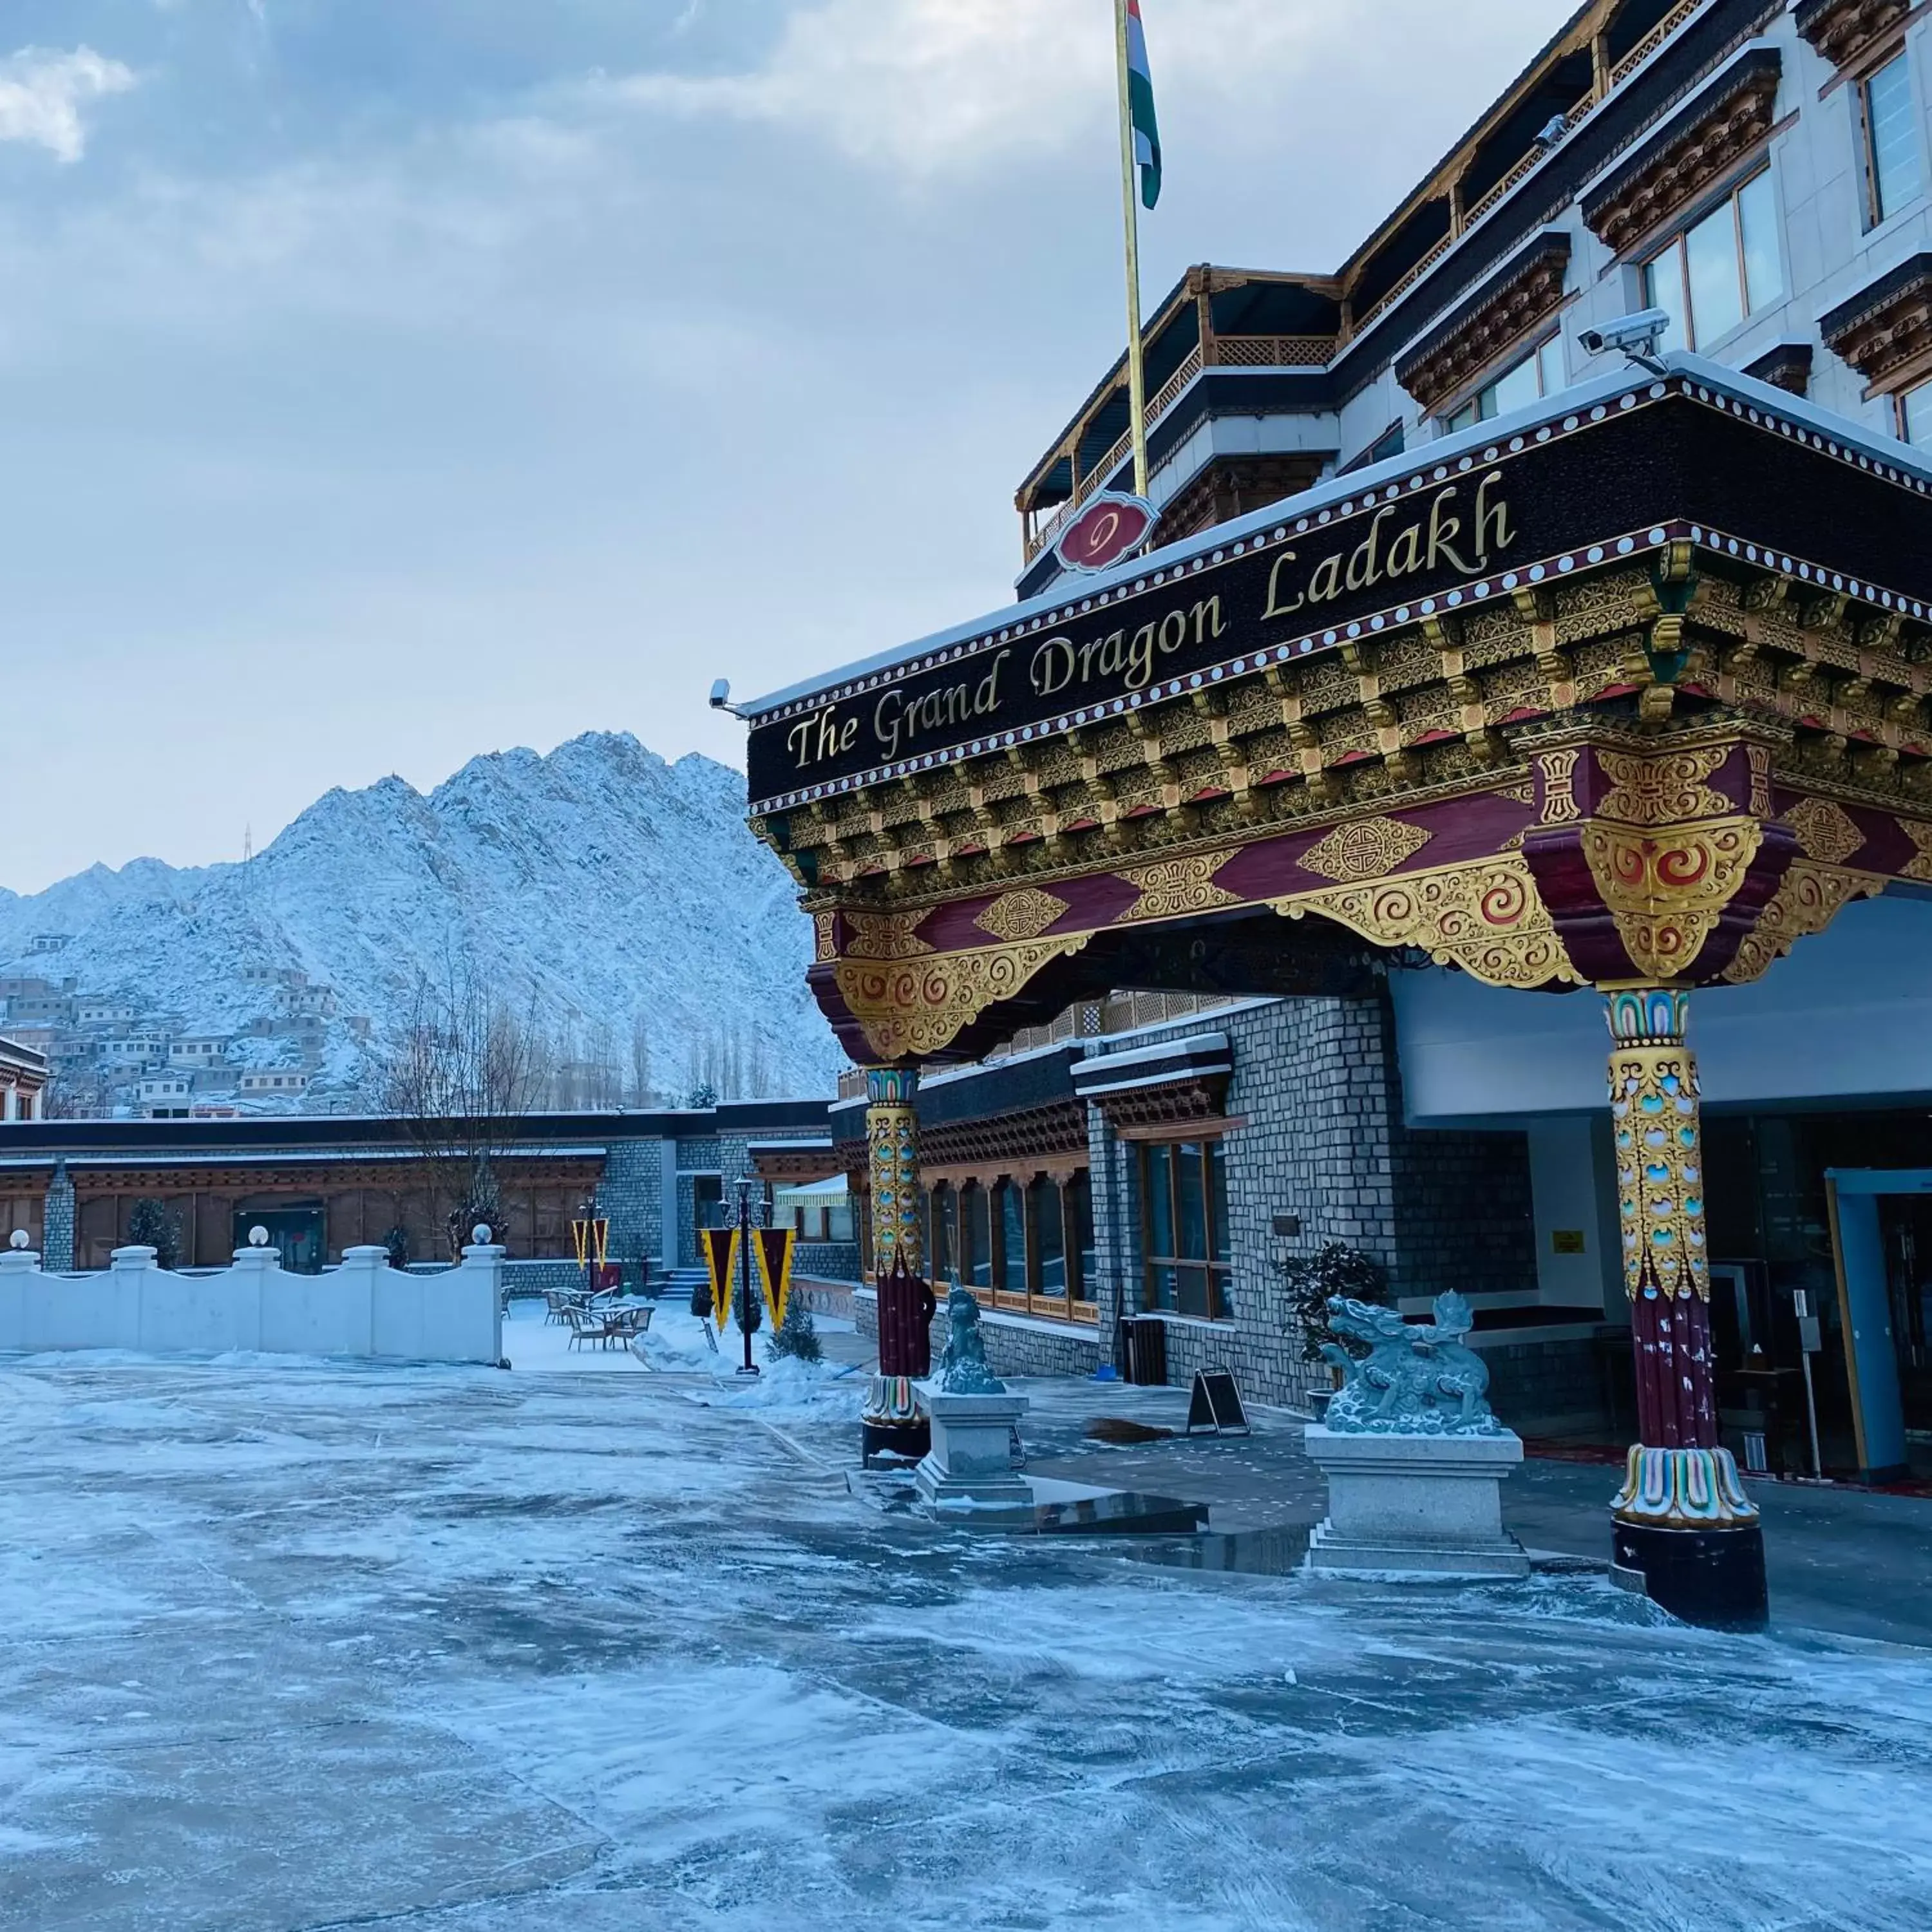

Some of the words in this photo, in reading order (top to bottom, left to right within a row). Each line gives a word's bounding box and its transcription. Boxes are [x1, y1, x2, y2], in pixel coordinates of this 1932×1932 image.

[788, 705, 858, 768] The
[874, 649, 1010, 761] Grand
[1030, 595, 1227, 697] Dragon
[1260, 471, 1517, 621] Ladakh
